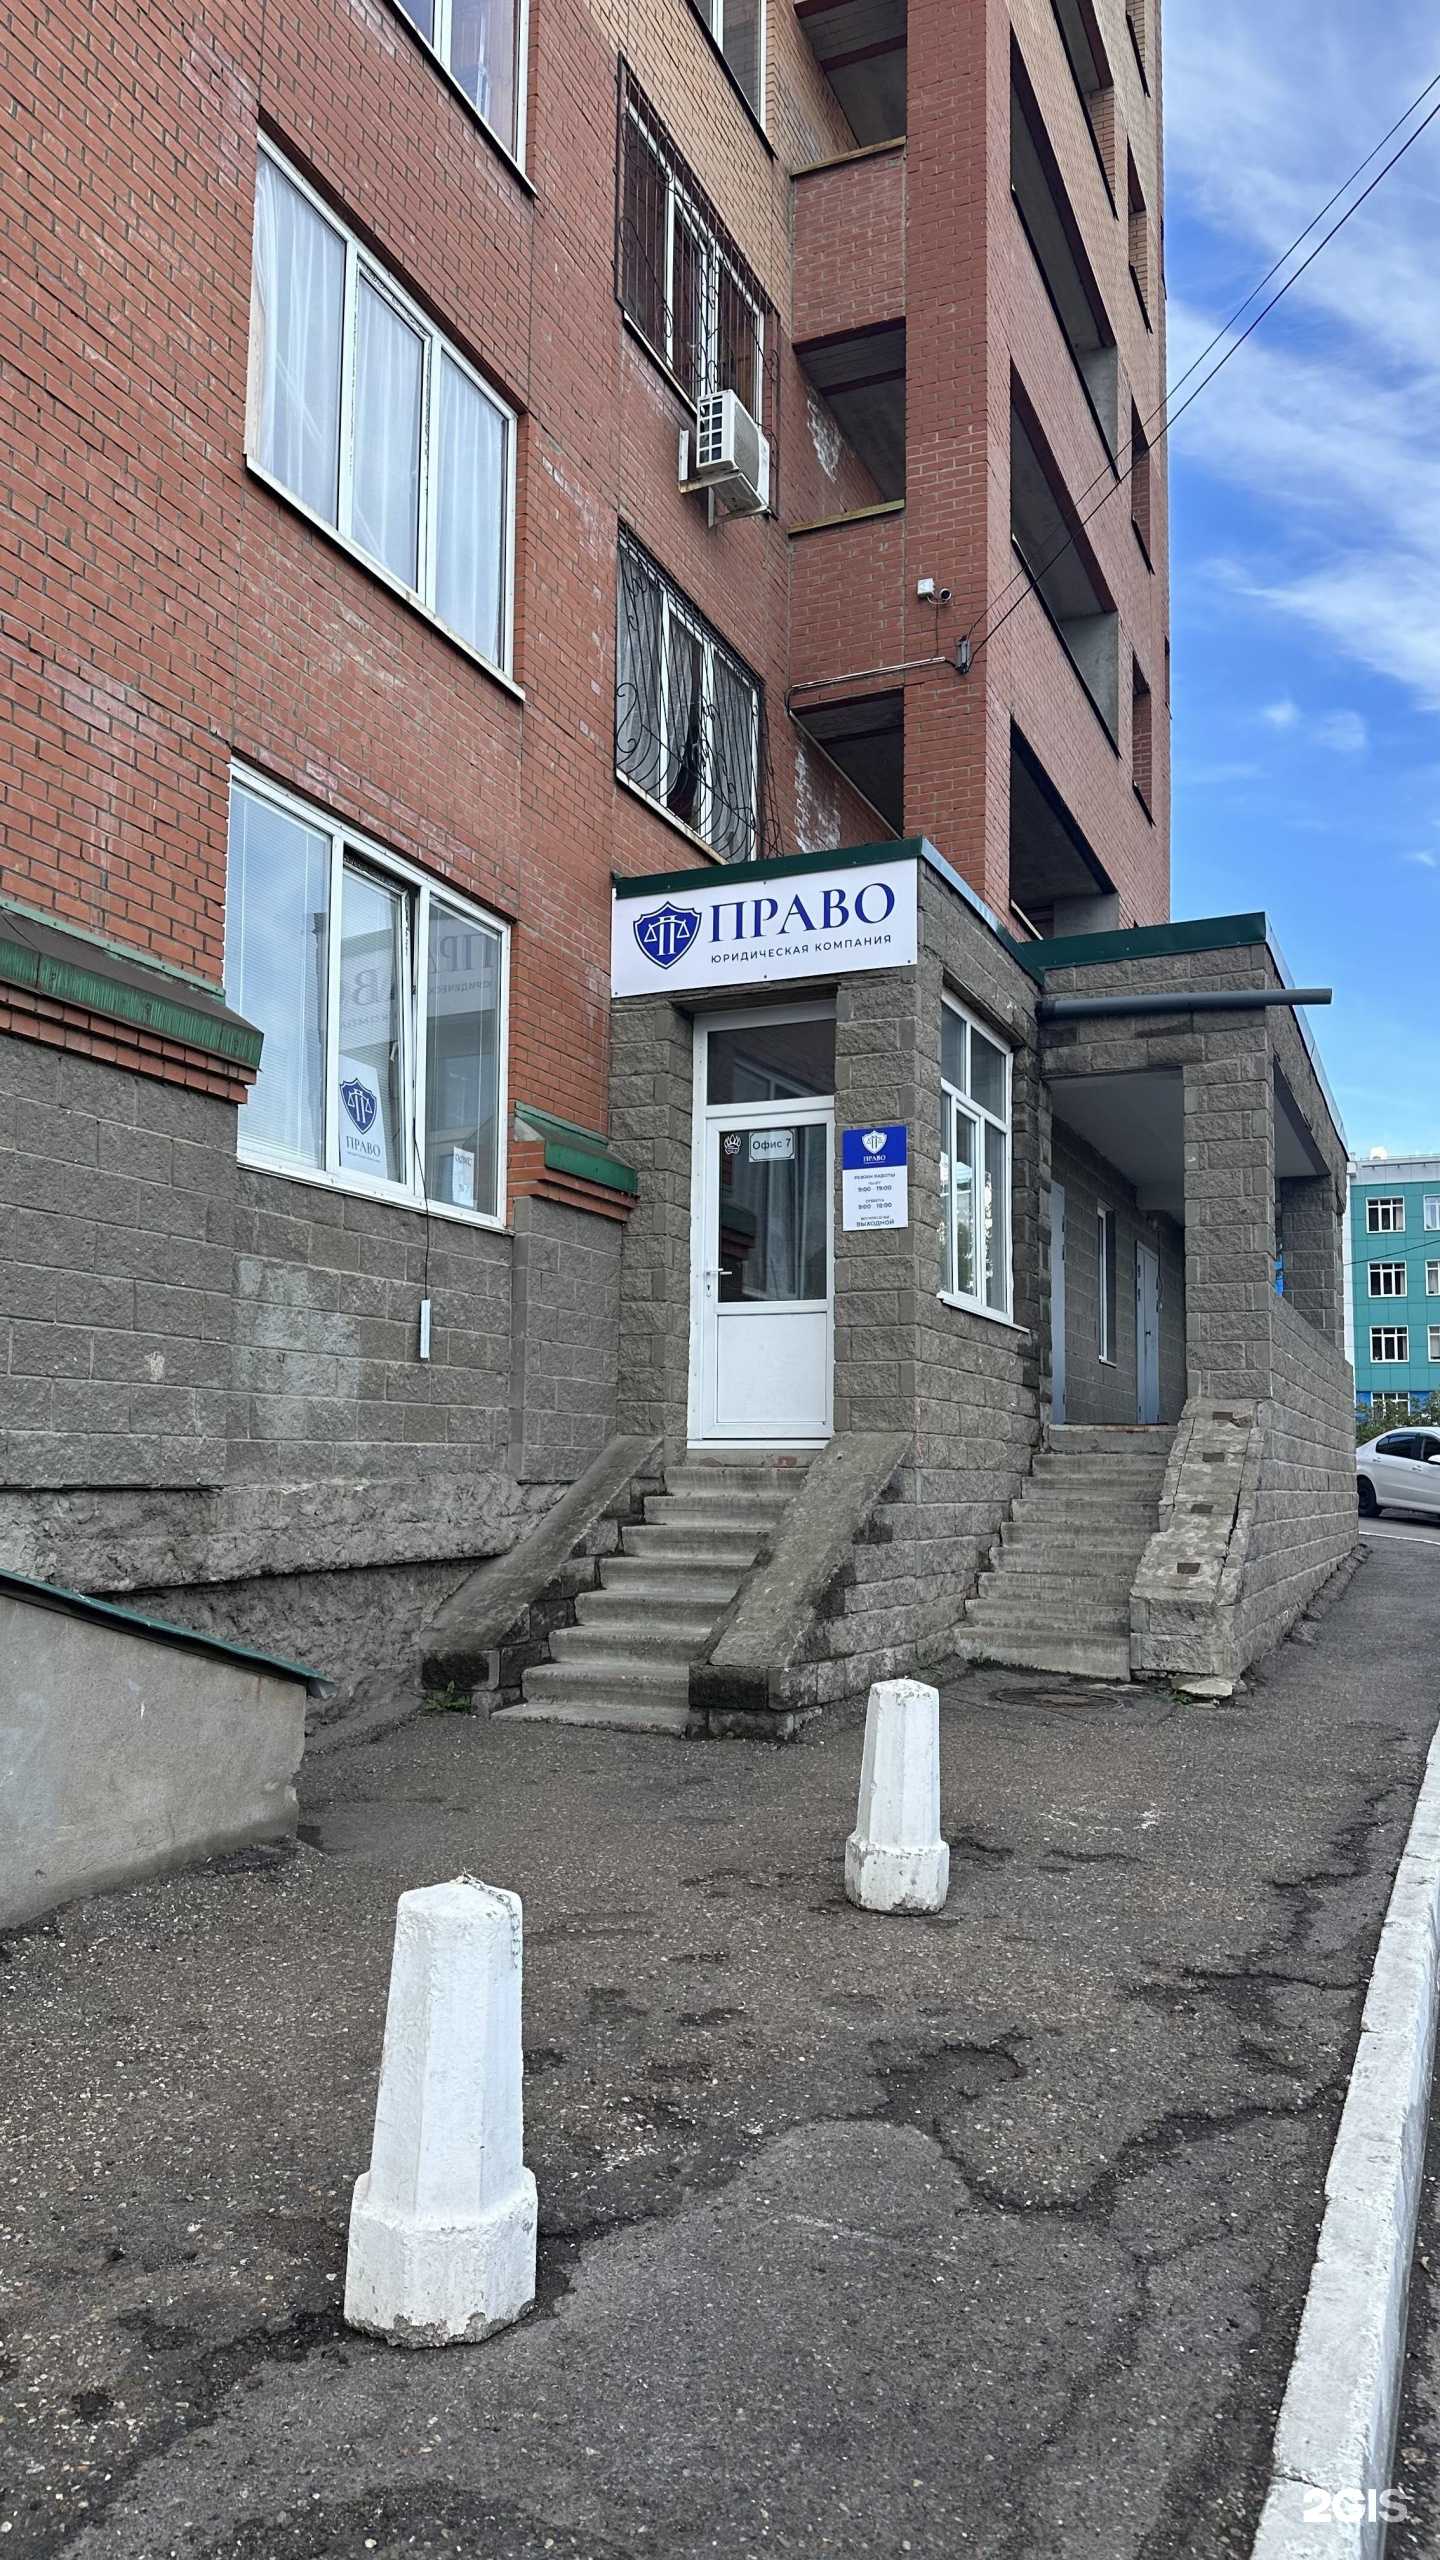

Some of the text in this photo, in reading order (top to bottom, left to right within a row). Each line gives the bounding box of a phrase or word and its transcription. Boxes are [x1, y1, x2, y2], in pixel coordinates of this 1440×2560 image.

[708, 882, 895, 943] ПРАВО
[711, 934, 892, 964] ЮРИДИЧЕСКАЯ КОМПАНИЯ
[346, 1135, 381, 1157] ПРАВО
[752, 1138, 791, 1151] Офис 7
